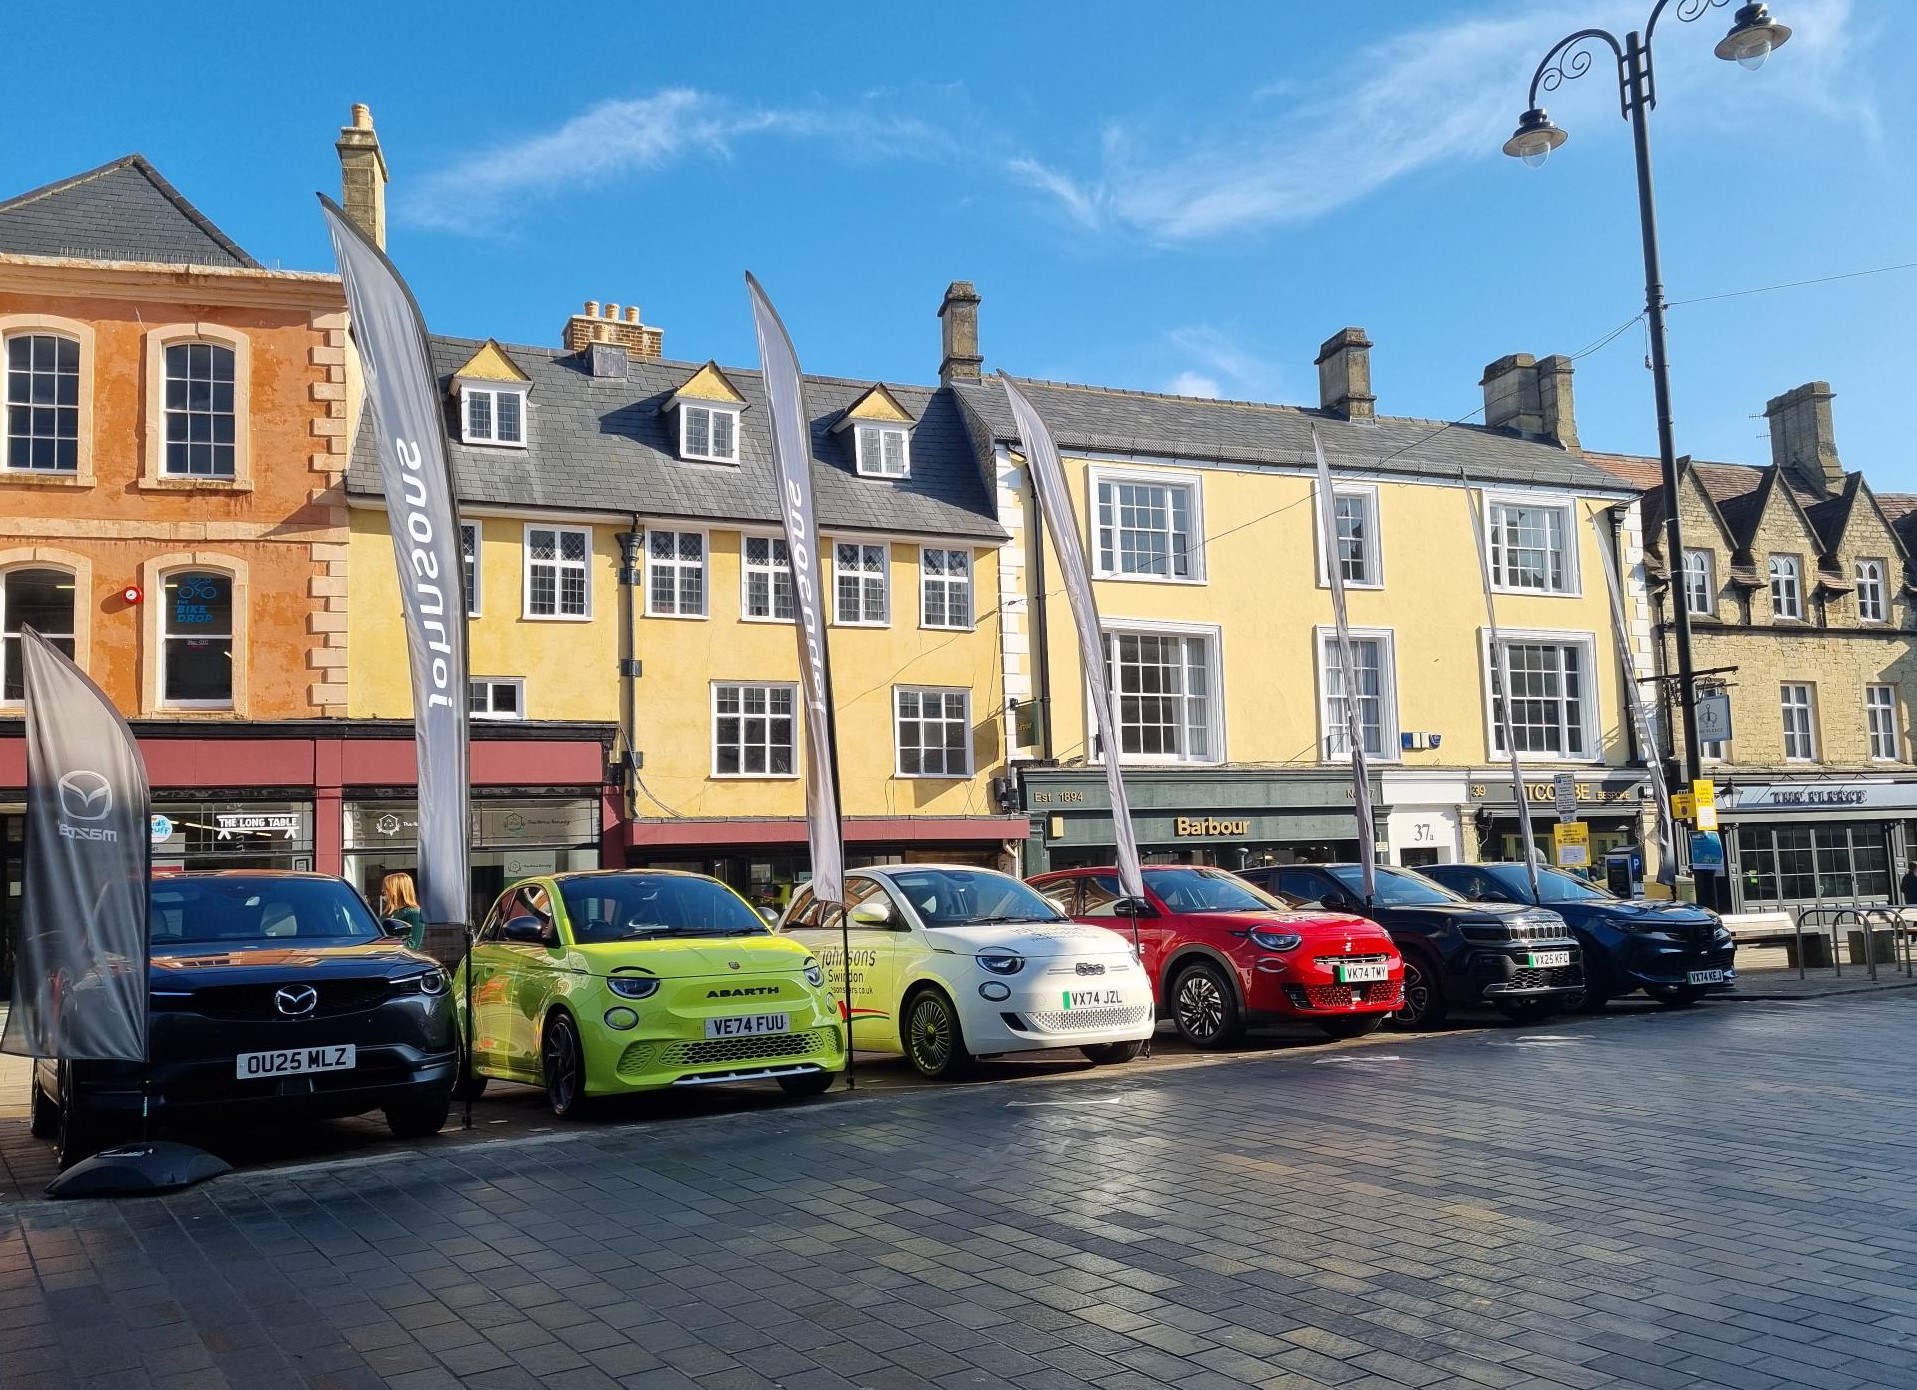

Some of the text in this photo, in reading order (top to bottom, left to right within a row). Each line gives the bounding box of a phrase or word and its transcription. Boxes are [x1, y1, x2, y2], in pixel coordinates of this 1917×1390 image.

[177, 605, 206, 614] BIKE
[177, 614, 213, 623] DROP
[1034, 791, 1083, 802] Est. 1894
[1473, 784, 1631, 800] 39 TCOBE BESPOKE
[219, 818, 297, 827] THE LONG TABLE
[1175, 816, 1250, 837] Barbour
[1414, 823, 1434, 841] 37a
[1633, 858, 1640, 870] P
[1535, 954, 1553, 965] VX25
[1347, 966, 1386, 979] VK74 TMY
[706, 986, 779, 998] ABARTH
[1071, 990, 1122, 1006] VX74 JZL
[714, 1015, 784, 1035] VE74 FUU
[247, 1047, 347, 1074] OU25 MLZ
